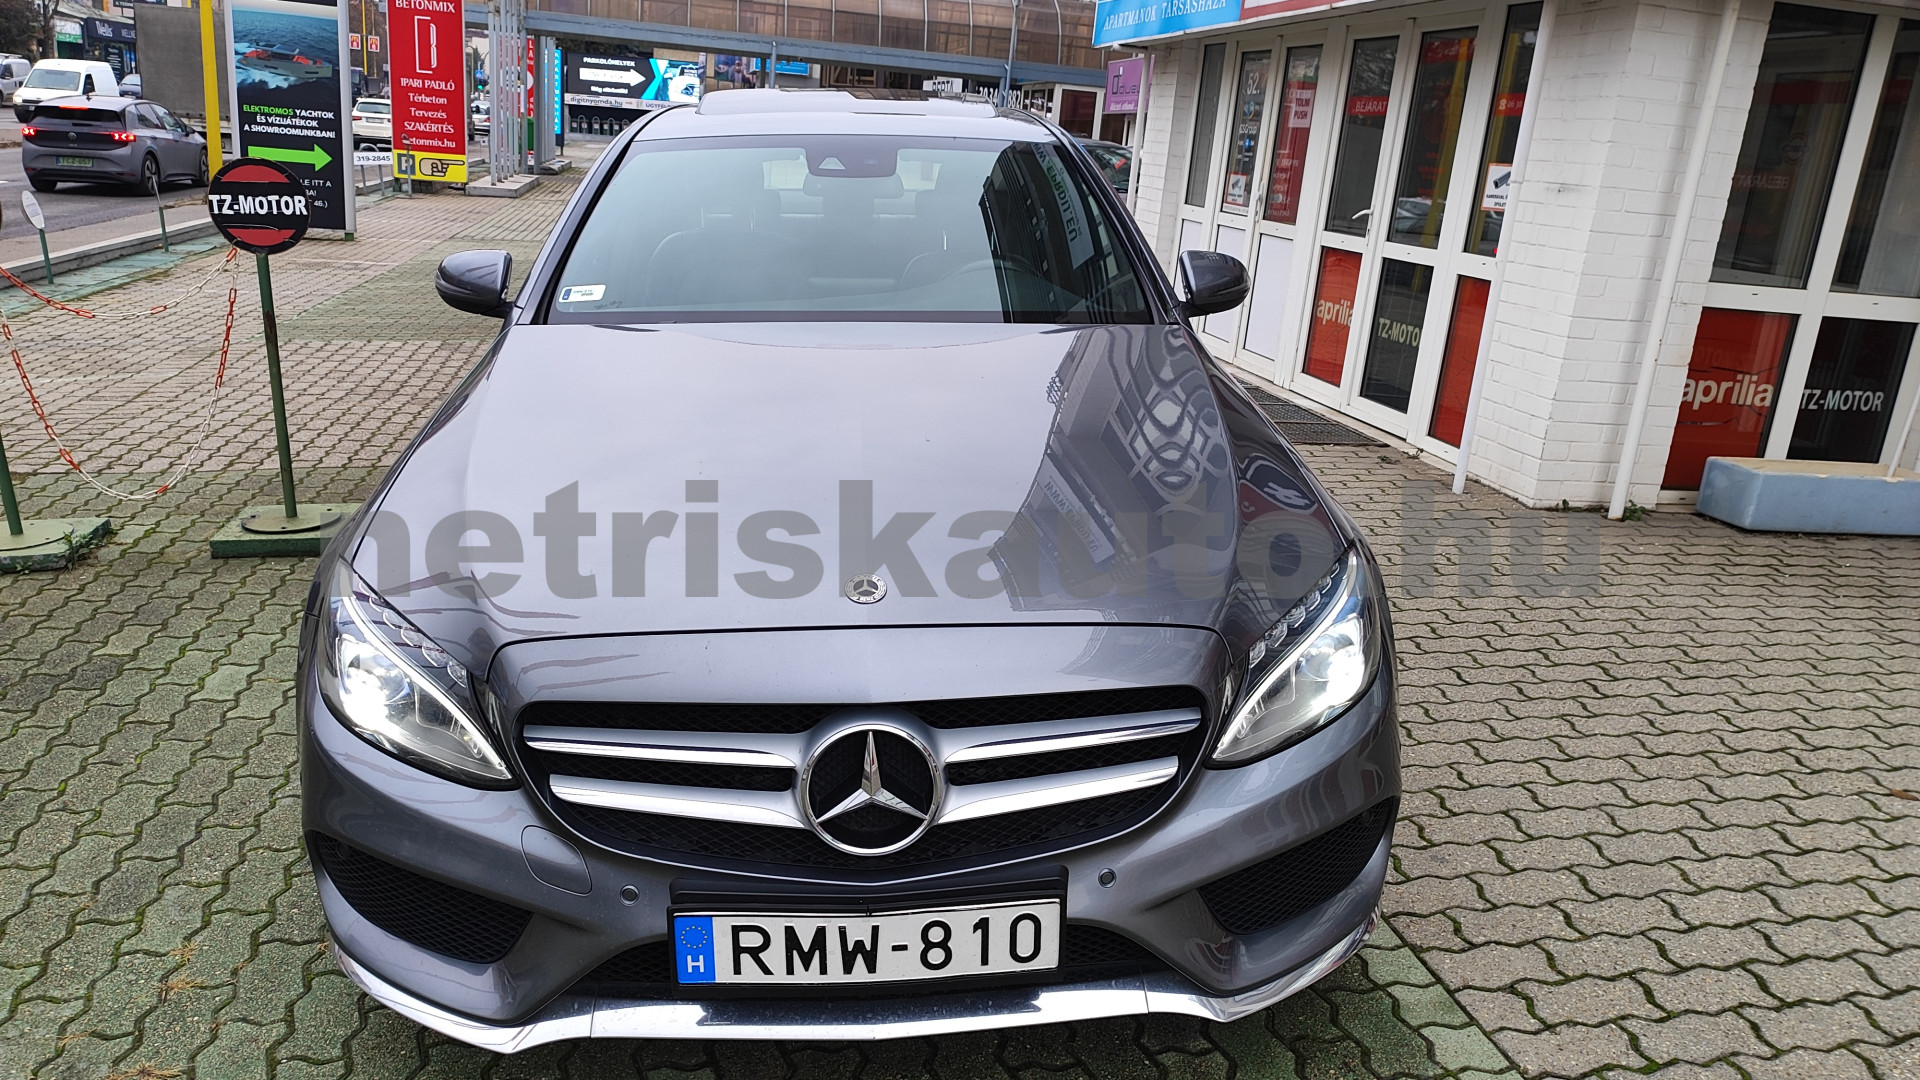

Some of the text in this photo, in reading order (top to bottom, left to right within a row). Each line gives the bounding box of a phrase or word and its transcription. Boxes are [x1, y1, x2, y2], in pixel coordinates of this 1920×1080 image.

[395, 0, 456, 13] BETONMIX
[1103, 4, 1158, 31] APARTMANOK
[400, 77, 456, 91] IPARI PADLÓ
[408, 92, 448, 104] Térbeton
[570, 96, 623, 107] digitnyomda.hu
[242, 104, 335, 120] ELEKTROMOS YACHTOK
[256, 113, 267, 123] ÉS
[409, 107, 447, 119] Tervezés
[251, 125, 336, 139] SHOWROOMUNKBAN!
[404, 120, 455, 134] SZAKÉRTÉS
[325, 180, 332, 188] A
[208, 194, 308, 215] TZ-MOTOR
[1681, 374, 1775, 410] aprilia
[1800, 388, 1885, 412] TZ-MOTOR
[730, 912, 1042, 976] RMW-810
[686, 954, 705, 973] H
